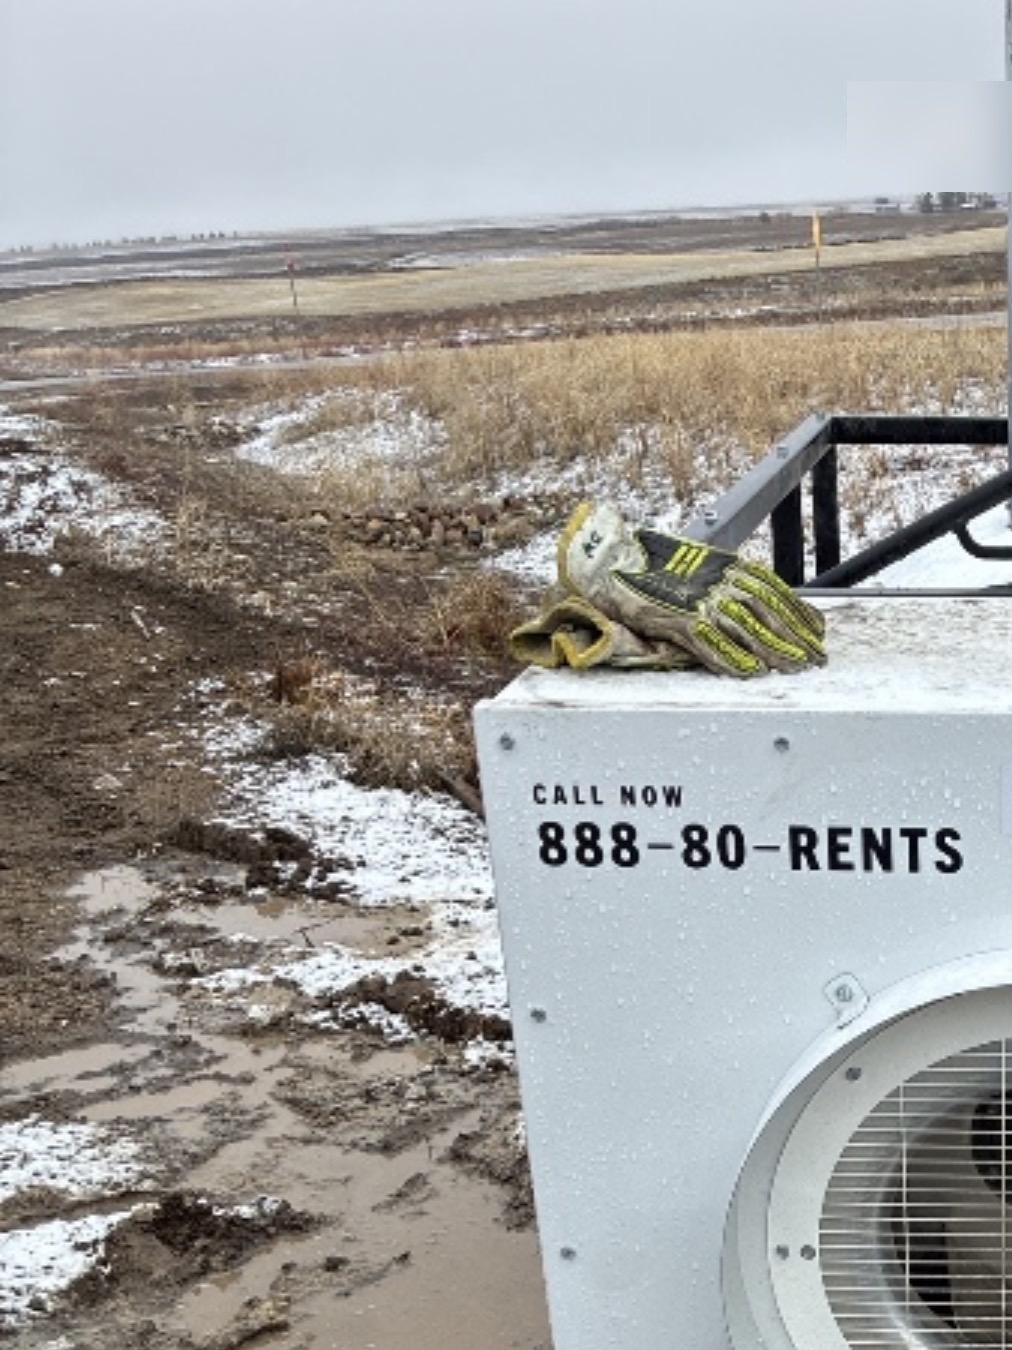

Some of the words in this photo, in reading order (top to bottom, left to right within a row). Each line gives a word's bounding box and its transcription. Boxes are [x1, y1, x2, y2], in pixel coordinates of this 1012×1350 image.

[532, 783, 604, 805] CALL
[619, 785, 684, 808] NOW
[537, 820, 964, 874] 888-80-RENTS
